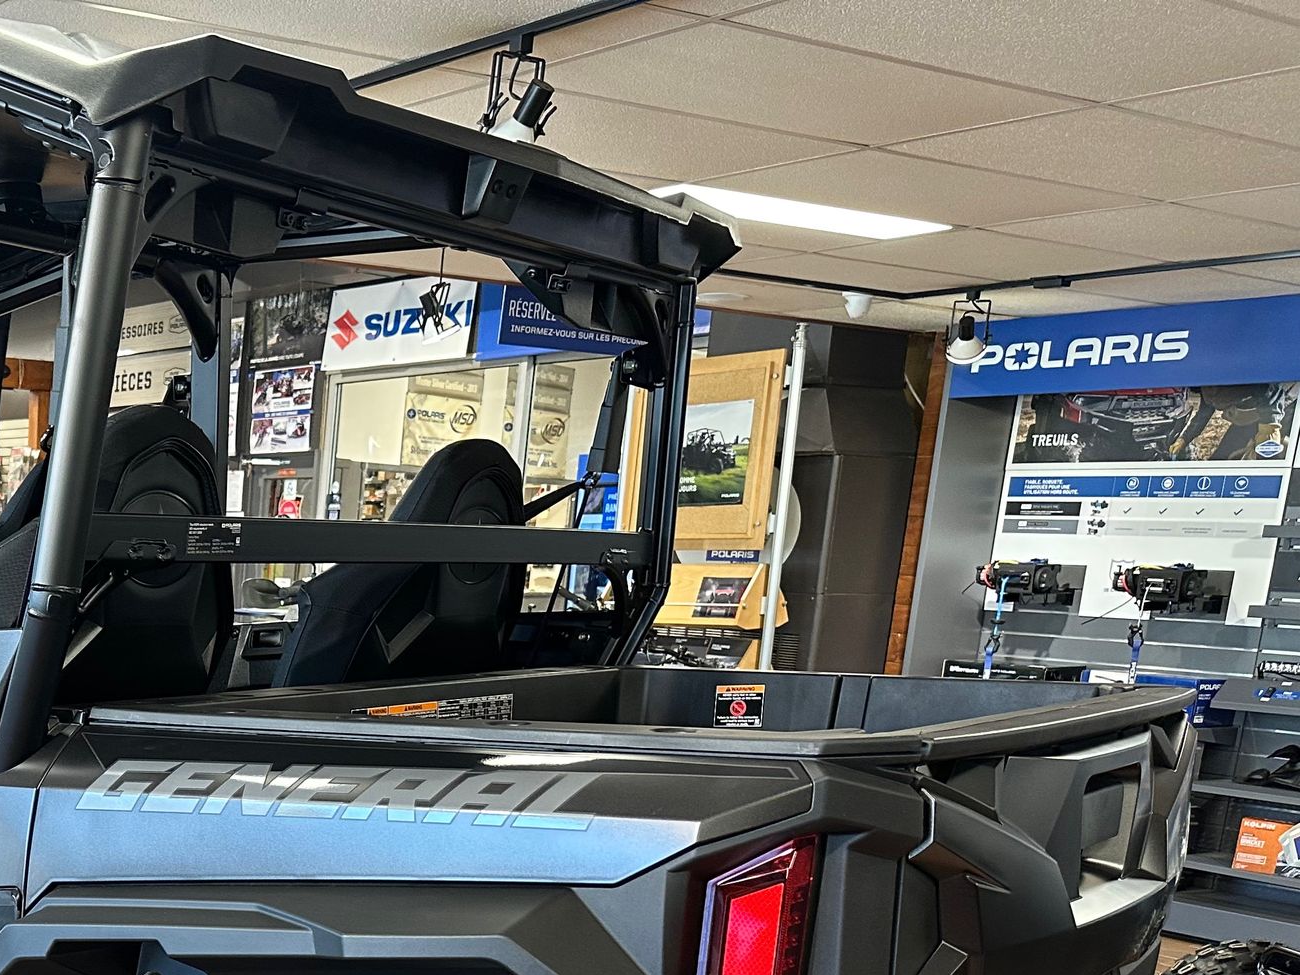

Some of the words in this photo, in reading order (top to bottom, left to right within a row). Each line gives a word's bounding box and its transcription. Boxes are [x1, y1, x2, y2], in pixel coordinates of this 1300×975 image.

[364, 300, 473, 341] SUZKI
[511, 324, 576, 339] INFORMEZ-VOUS
[578, 331, 594, 340] SUR
[596, 333, 610, 342] LES
[970, 330, 1190, 374] POLARIS
[114, 370, 152, 392] IÈCES
[1031, 433, 1079, 447] TREUILS
[711, 550, 755, 559] POLARIS
[75, 760, 602, 832] GENERAL
